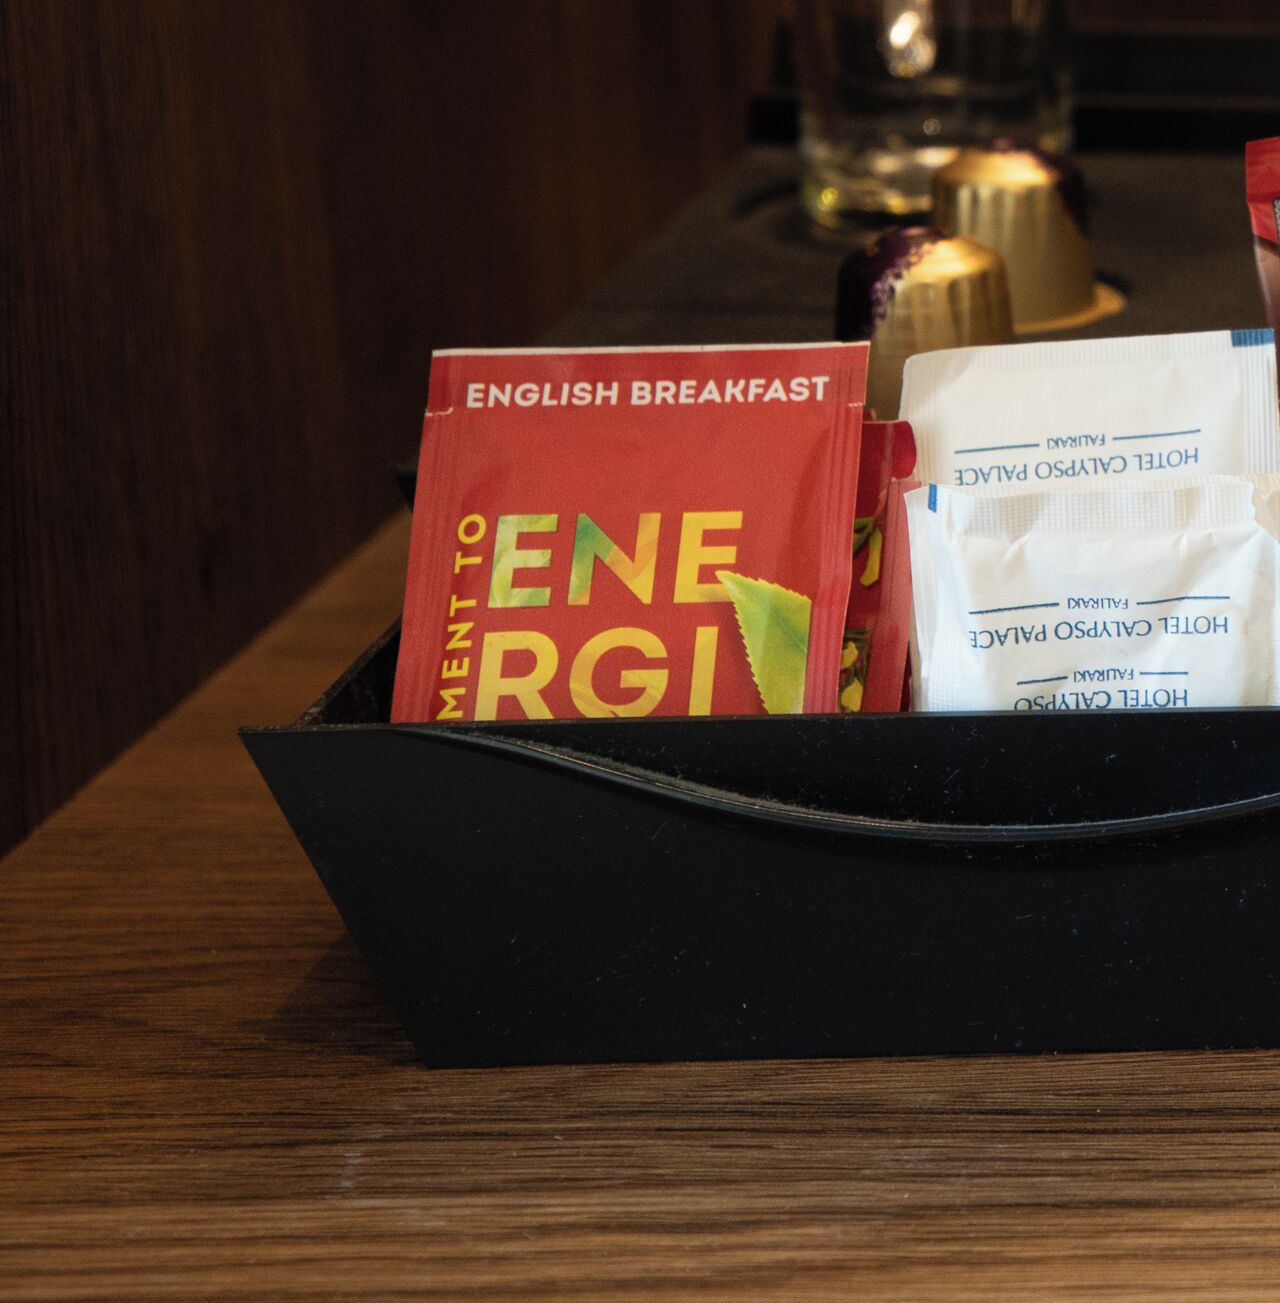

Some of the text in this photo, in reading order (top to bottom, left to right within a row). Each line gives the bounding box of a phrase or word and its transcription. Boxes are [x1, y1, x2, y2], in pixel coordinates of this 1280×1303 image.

[466, 376, 829, 408] ENGLISH BREAKFAST
[1047, 433, 1105, 450] FALIRAKI
[954, 447, 1198, 486] HOTEL CALYPSO PALACE
[487, 510, 743, 609] ENE
[436, 513, 486, 720] MENT TO
[1067, 597, 1128, 609] FALIRAKI
[969, 616, 1228, 648] HOTEL CALYPSO PALACE
[474, 626, 719, 721] RGI
[1073, 668, 1134, 683] FALIRAKI
[1014, 689, 1188, 710] HOTEL CALYPSO
